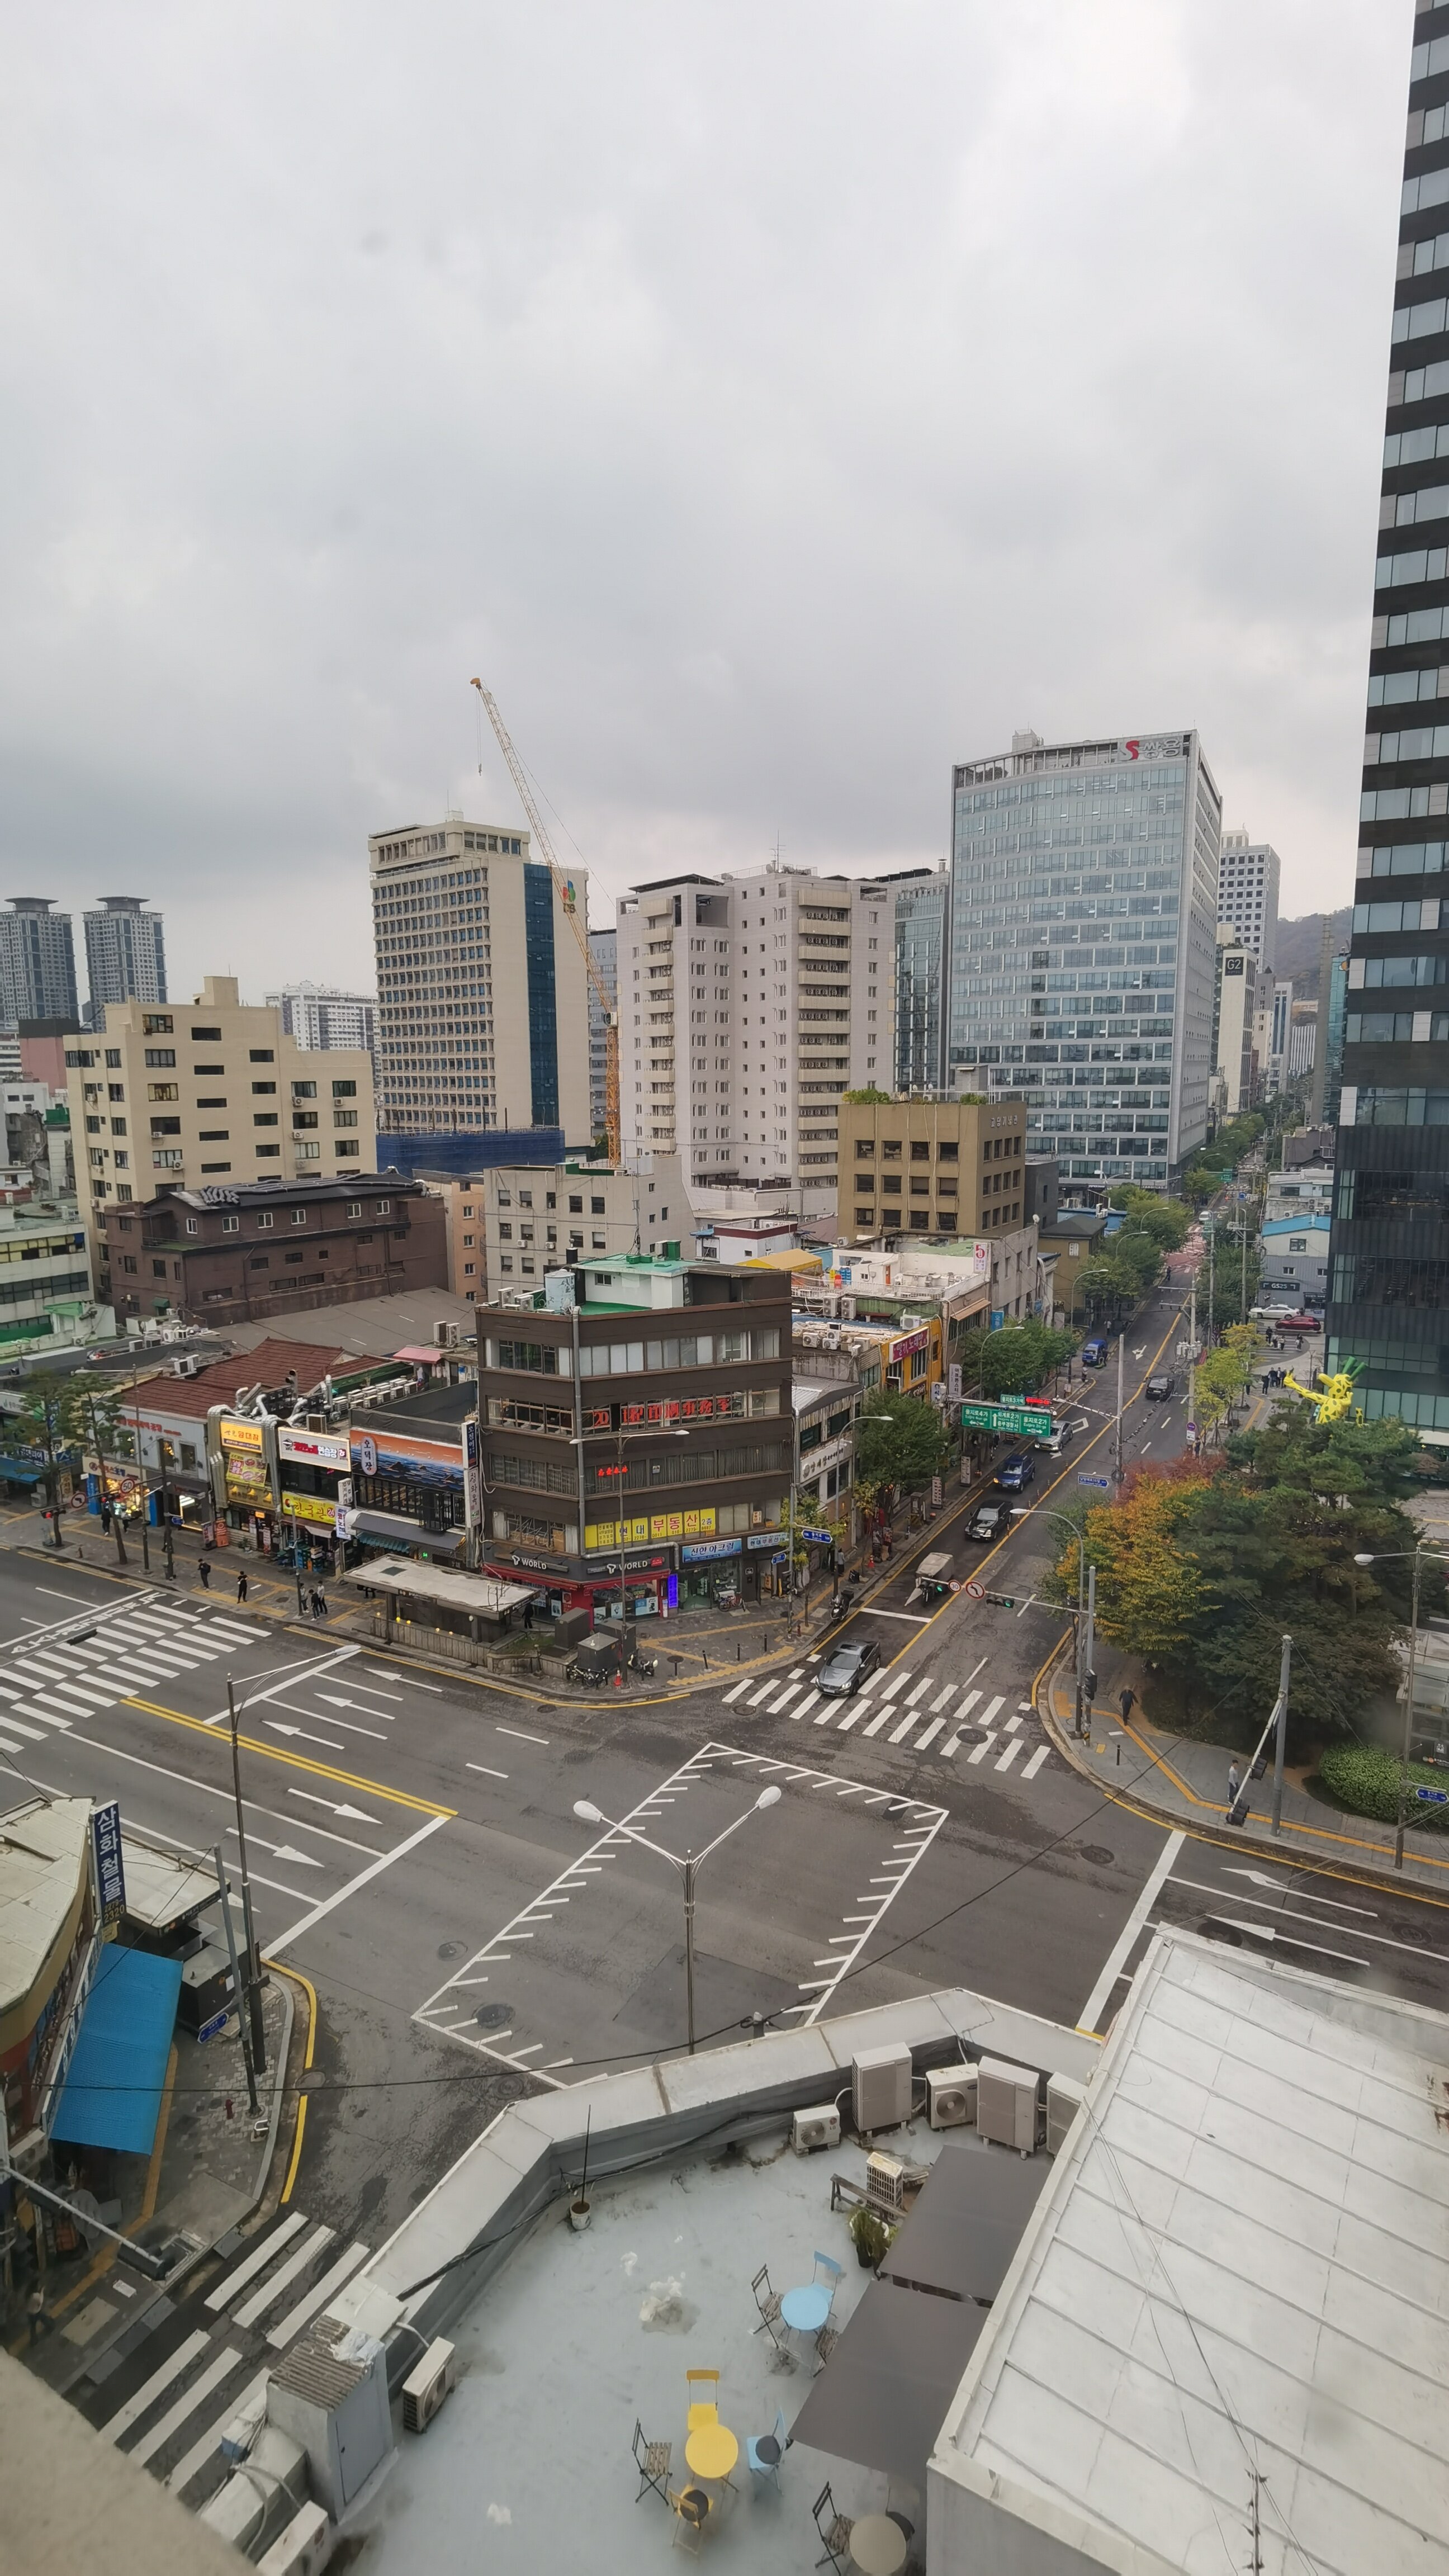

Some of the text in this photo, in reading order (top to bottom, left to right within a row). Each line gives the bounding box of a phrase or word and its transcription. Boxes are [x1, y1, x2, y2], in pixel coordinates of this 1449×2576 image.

[1144, 738, 1180, 759] 쌍용
[1228, 959, 1241, 969] G2
[965, 1408, 988, 1417] 을지로4가
[1024, 1416, 1047, 1425] 을지로2가
[318, 1446, 338, 1459] 연습장
[122, 1482, 132, 1490] 50
[295, 1501, 326, 1519] 한국관
[654, 1514, 698, 1532] 부동산
[691, 1542, 735, 1556] 신한 아크릴
[520, 1557, 547, 1570] WORLD
[619, 1560, 648, 1571] WORLD
[98, 1806, 122, 1902] 삼화철물
[104, 1905, 125, 1924] 2320
